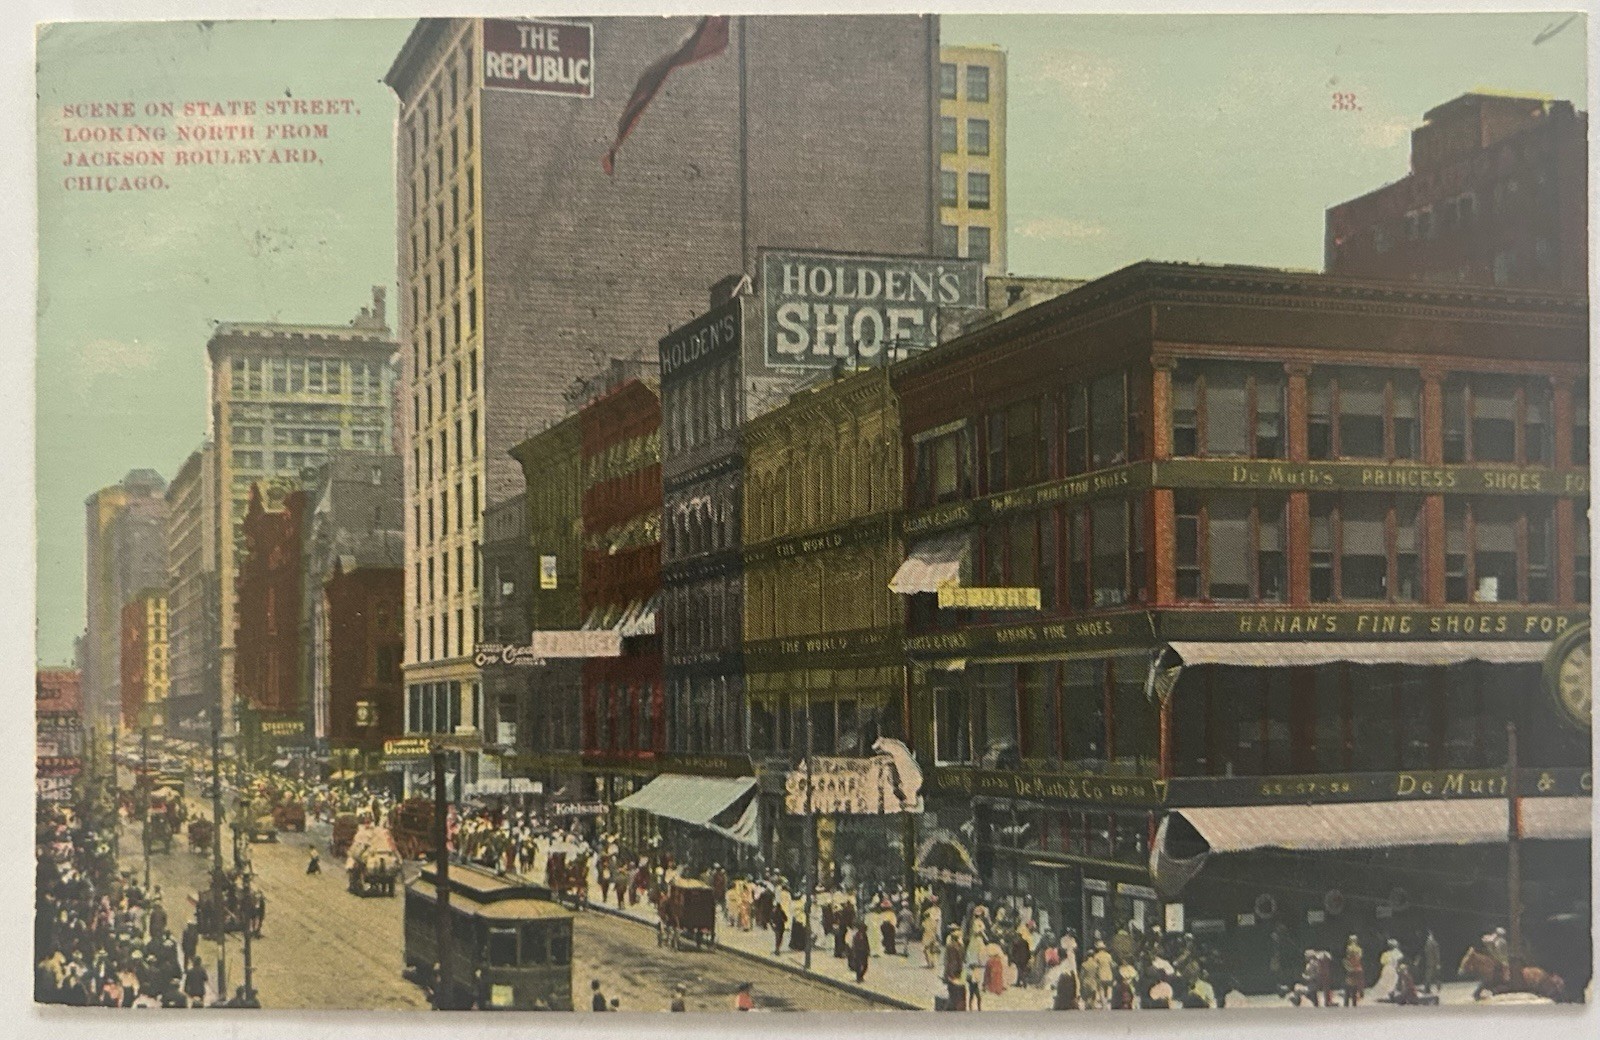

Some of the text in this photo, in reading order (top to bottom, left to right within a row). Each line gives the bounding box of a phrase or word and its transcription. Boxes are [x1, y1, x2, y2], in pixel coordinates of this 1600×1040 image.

[517, 25, 560, 51] THE
[486, 51, 590, 85] REPUBLIC
[63, 99, 361, 118] SCENE ON STATE STREET,
[63, 124, 329, 142] LOOKING NORTH FROM
[62, 149, 324, 168] JACKSON BOULEVARD,
[63, 175, 170, 193] CHICAGO.
[782, 263, 961, 304] HOLDEN'S
[776, 302, 937, 363] SHOE
[661, 314, 735, 376] HOLDEN'S
[1094, 471, 1128, 492] SHOES
[1232, 465, 1260, 484] De
[1267, 466, 1334, 485] Muth's
[1361, 468, 1456, 487] PRINCESS
[1483, 472, 1541, 491] SHOES
[803, 534, 842, 552] WORLD
[1043, 624, 1067, 640] FINE
[1076, 621, 1113, 636] SHOES
[1239, 613, 1569, 634] HANAN'S FINE SHOES FOR
[806, 636, 847, 652] WORLD
[1536, 772, 1555, 792] &
